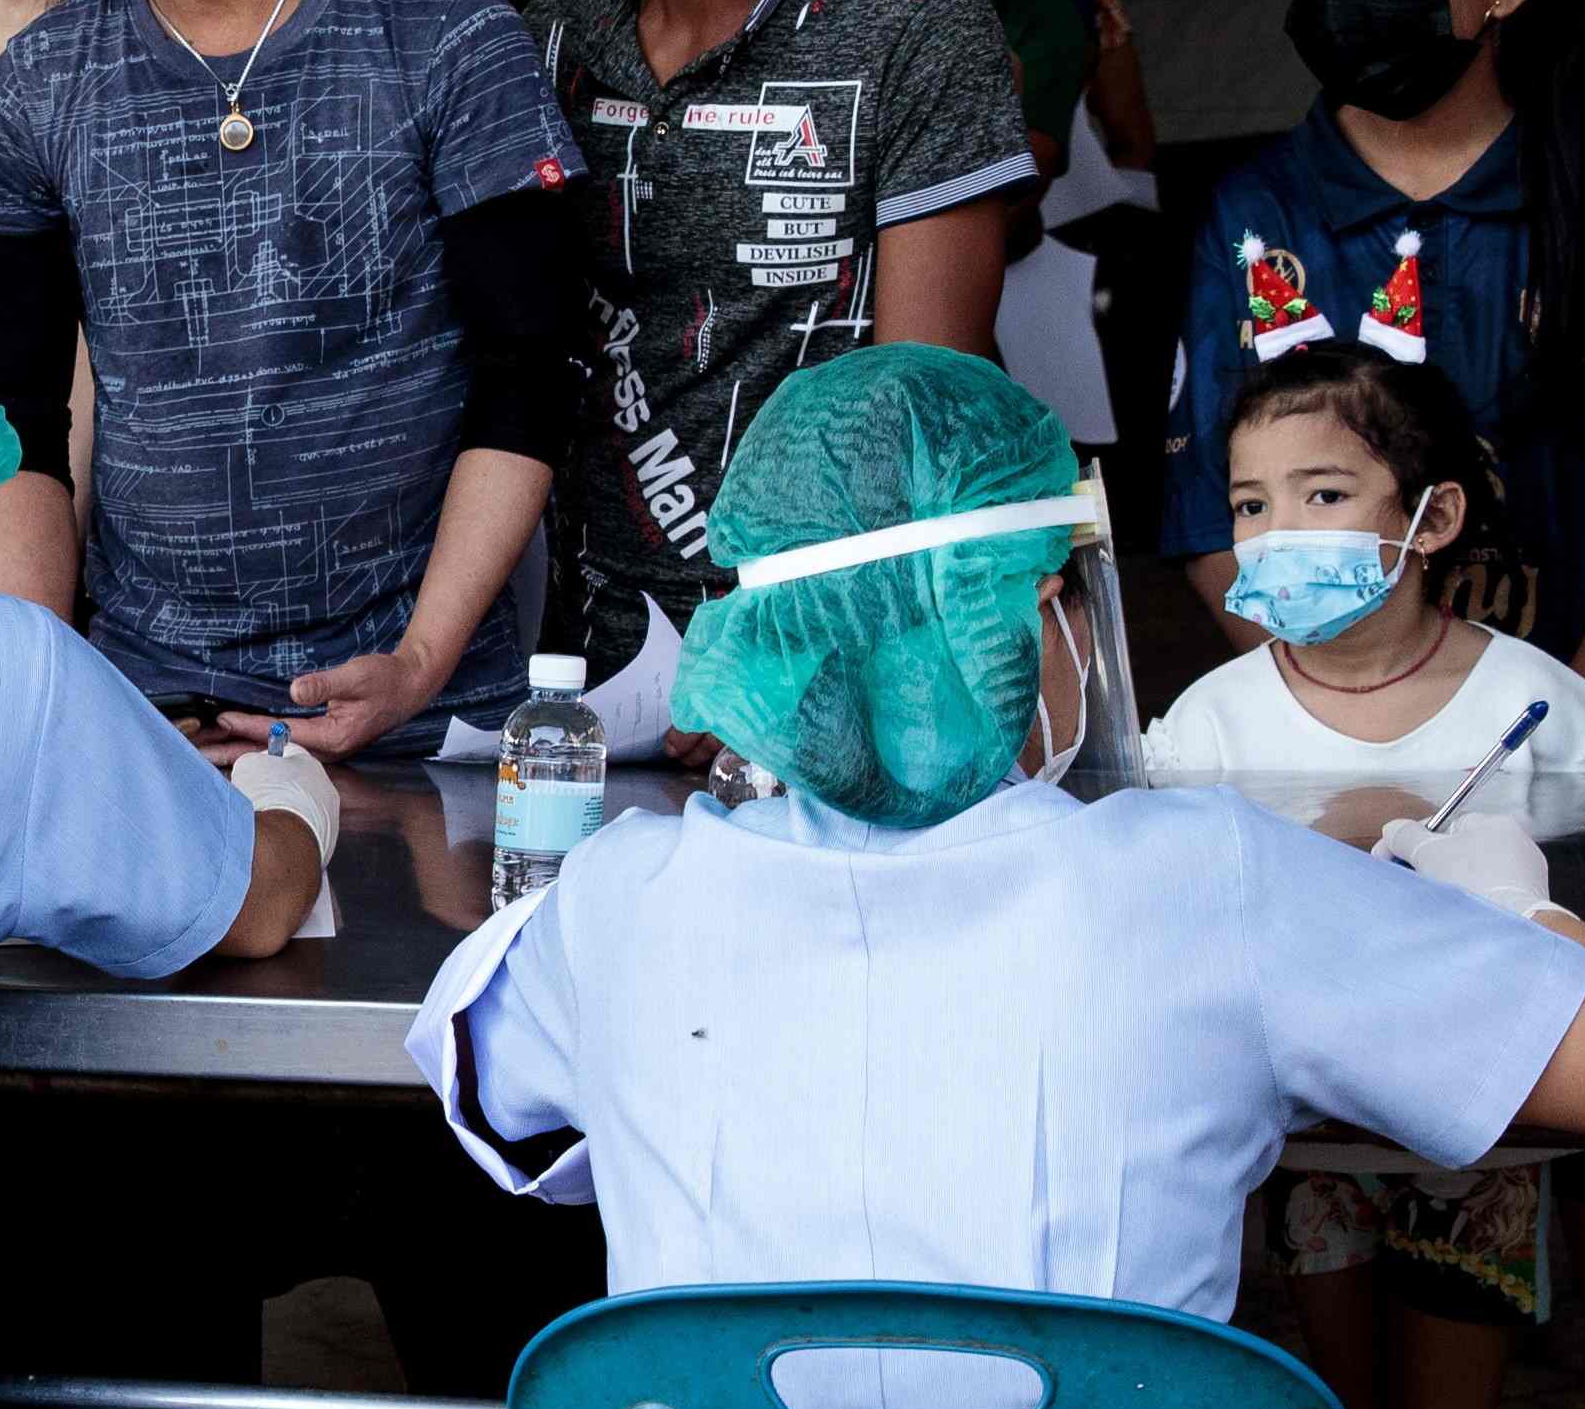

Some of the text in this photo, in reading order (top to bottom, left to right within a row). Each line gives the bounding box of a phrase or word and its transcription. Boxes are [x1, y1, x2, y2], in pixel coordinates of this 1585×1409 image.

[728, 107, 775, 125] rule
[779, 196, 832, 210] CUTE
[784, 221, 825, 236] BUT
[750, 244, 838, 261] DEVILISH
[766, 267, 828, 284] INSIDE
[628, 427, 708, 561] Man
